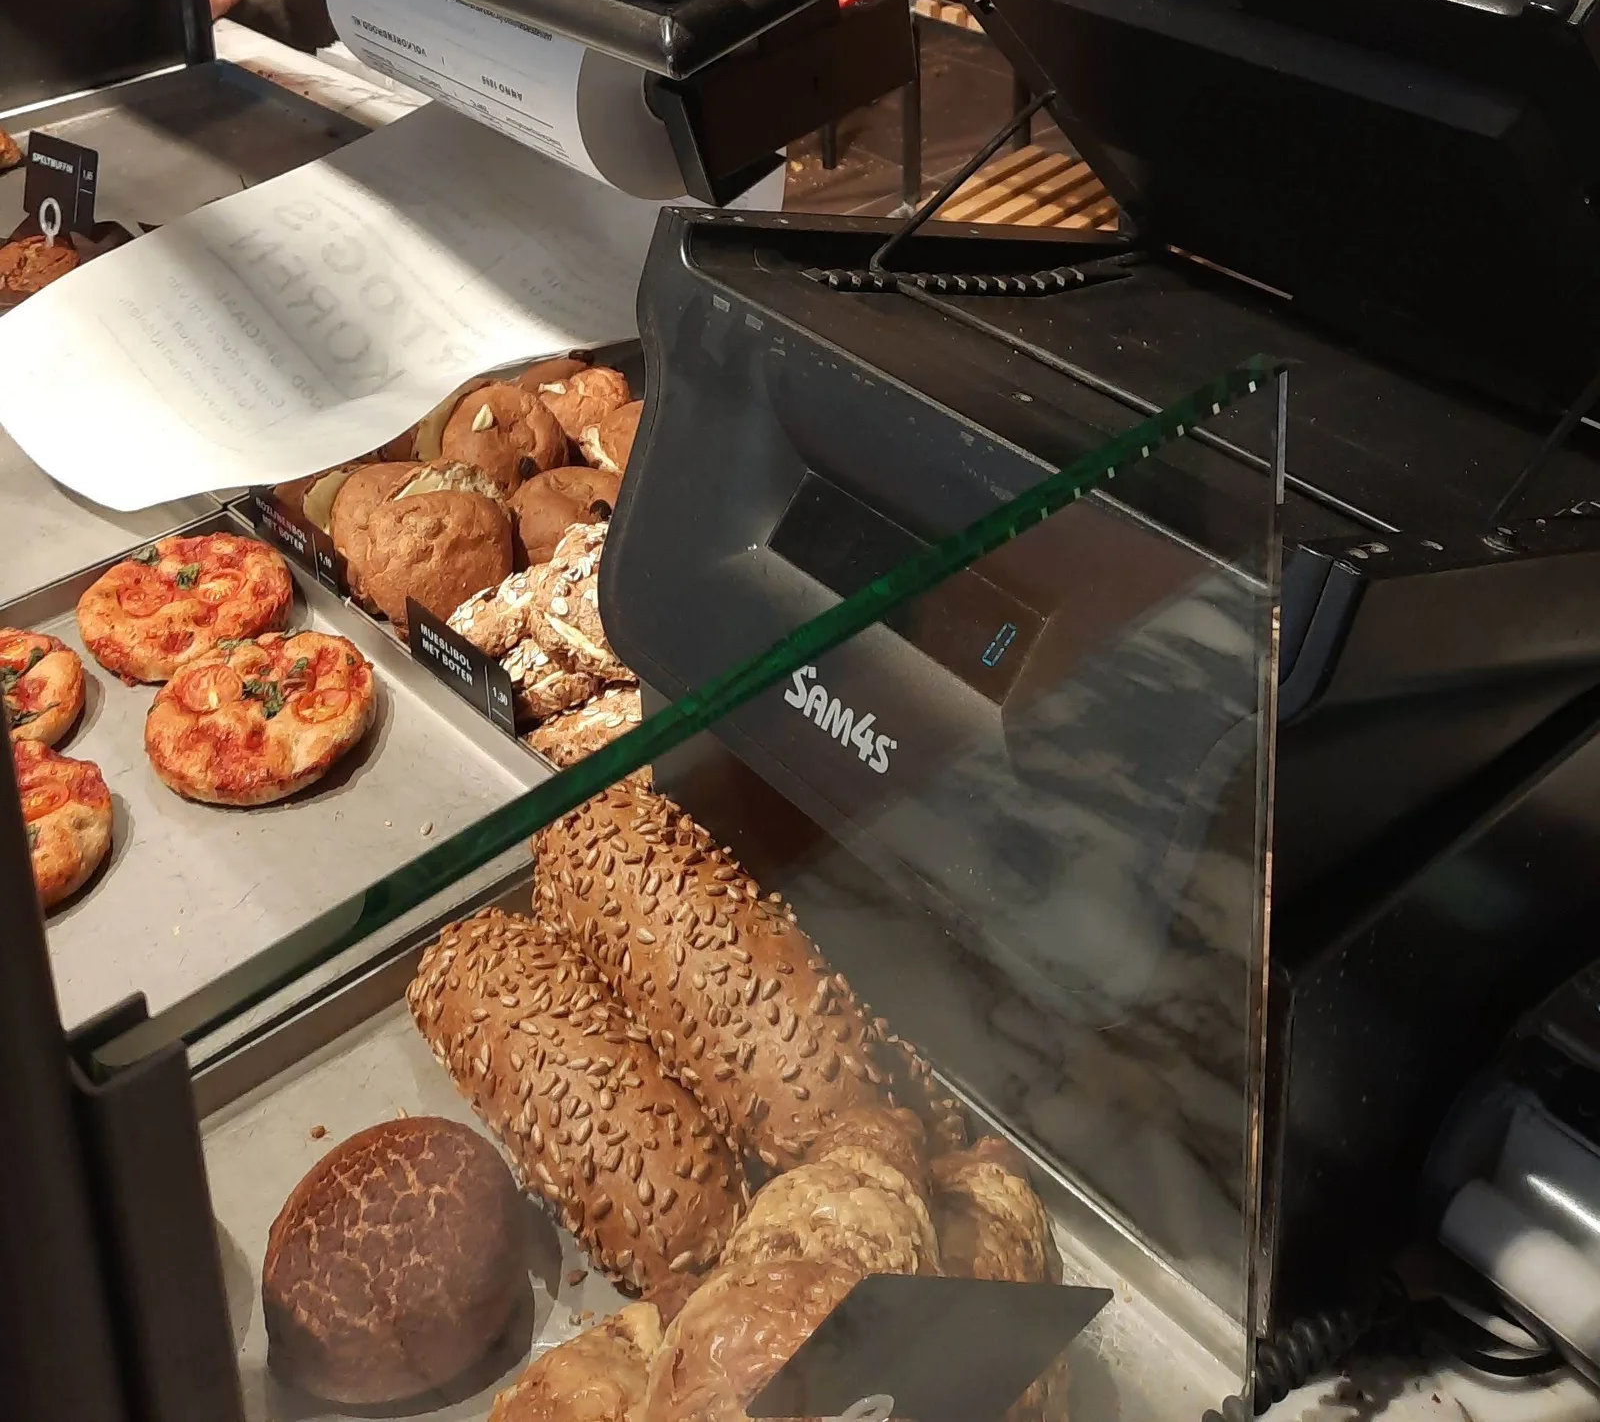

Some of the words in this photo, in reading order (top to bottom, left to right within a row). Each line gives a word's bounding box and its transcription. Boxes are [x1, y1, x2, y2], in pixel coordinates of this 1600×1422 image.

[498, 82, 523, 102] ANNO
[32, 152, 74, 174] SPELTMUFFIN
[420, 623, 472, 671] MUESLIBOL
[422, 638, 440, 660] MET
[442, 653, 473, 686] BOTER
[784, 665, 898, 773] SAM4S
